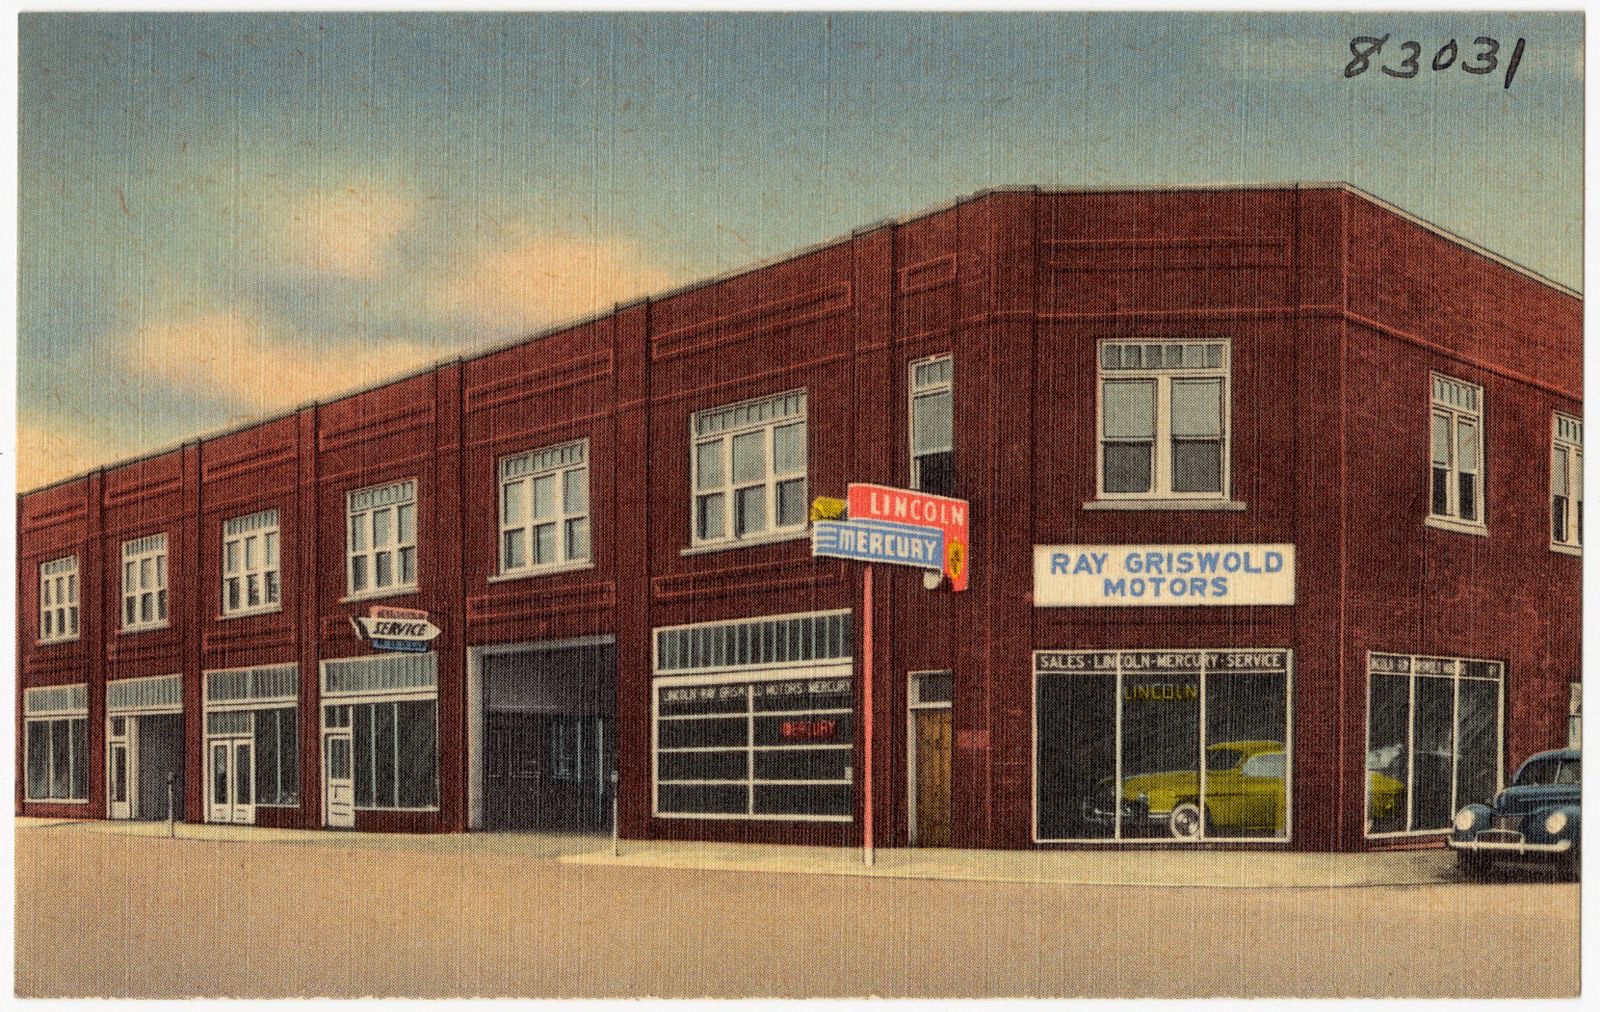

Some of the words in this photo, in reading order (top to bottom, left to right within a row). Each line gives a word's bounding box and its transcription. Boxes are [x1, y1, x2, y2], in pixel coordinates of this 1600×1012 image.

[1344, 32, 1527, 90] 83031
[869, 491, 965, 527] LINCOLN
[838, 529, 938, 562] MERCURY
[1050, 552, 1109, 576] RAY
[1125, 551, 1284, 575] GRISWOLD
[1103, 576, 1229, 598] MOTORS
[372, 621, 428, 637] SERVICE
[1040, 654, 1086, 669] SALES
[1226, 652, 1282, 668] SERVICE
[1124, 684, 1198, 700] LINCOLN
